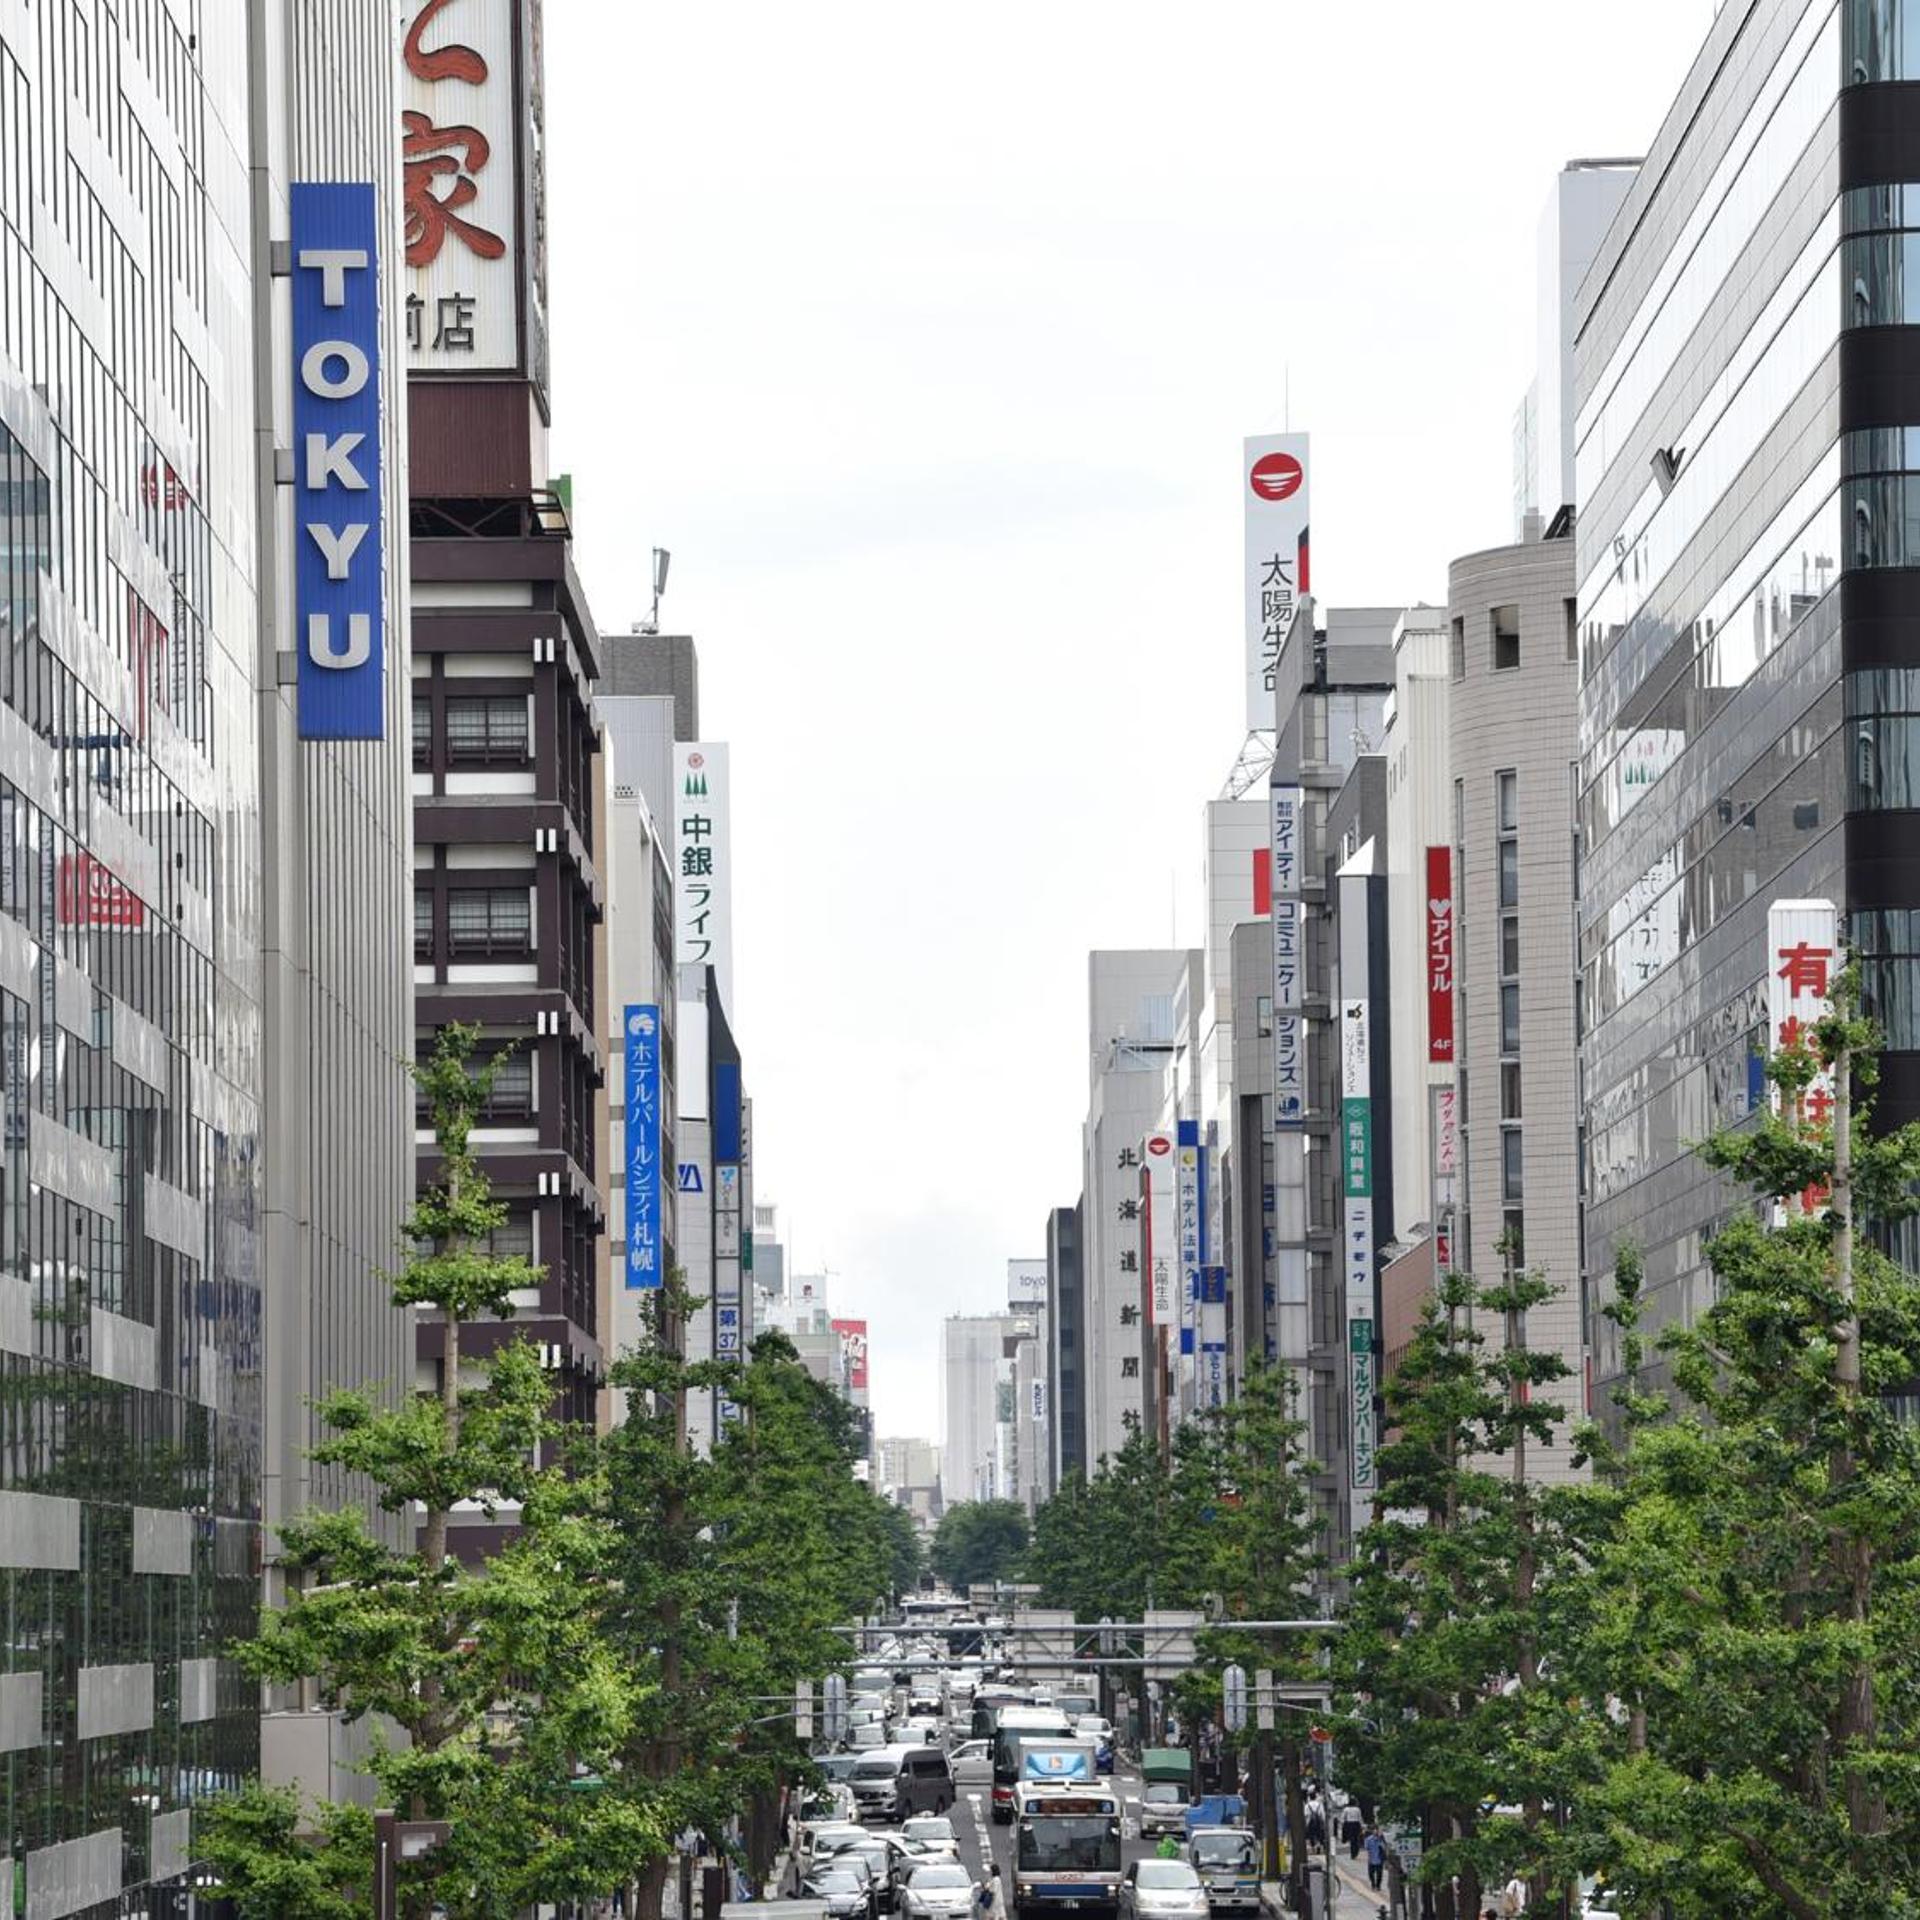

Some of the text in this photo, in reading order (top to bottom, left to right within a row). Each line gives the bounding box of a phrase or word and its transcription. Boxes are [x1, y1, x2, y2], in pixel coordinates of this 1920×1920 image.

[299, 249, 371, 669] TOKYU
[681, 813, 712, 964] 中銀ライフ
[1431, 919, 1451, 992] アイフル
[630, 1041, 655, 1272] ホテルパールシティ札幌
[1117, 1147, 1142, 1432] 北海道新聞社
